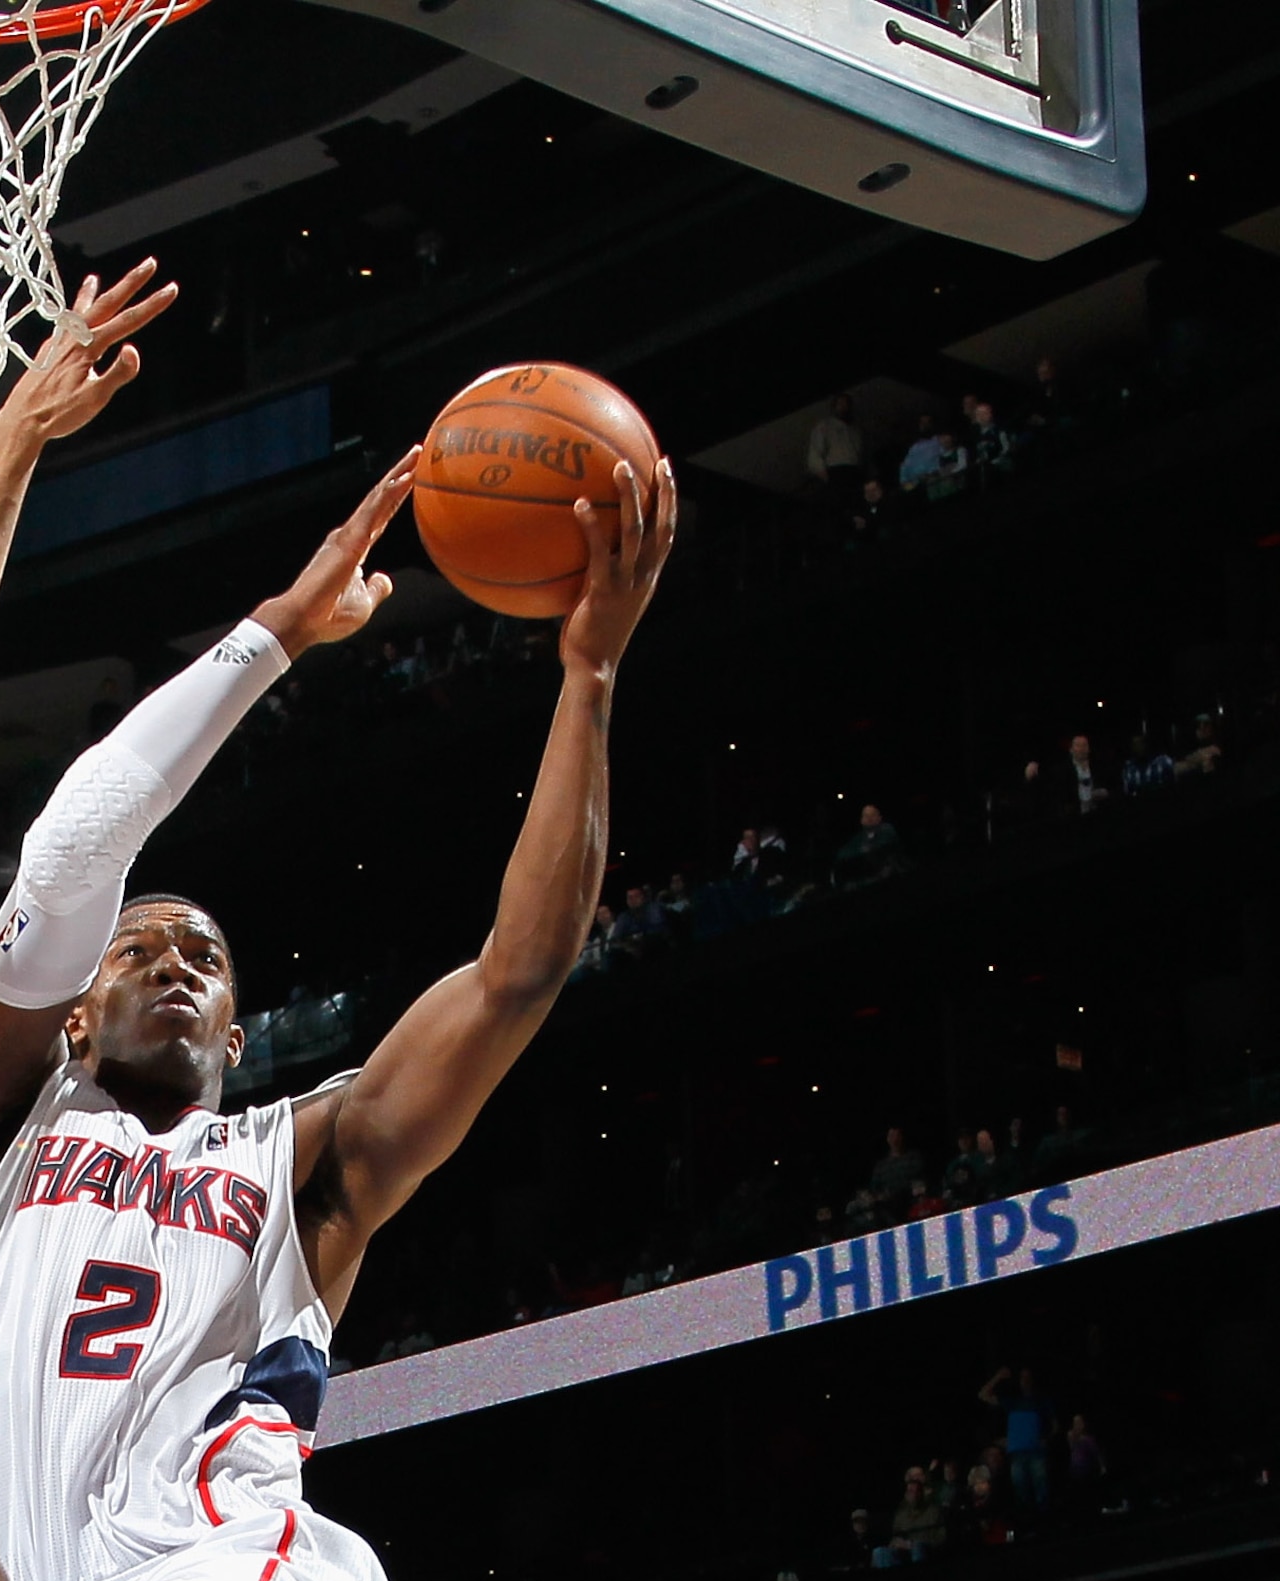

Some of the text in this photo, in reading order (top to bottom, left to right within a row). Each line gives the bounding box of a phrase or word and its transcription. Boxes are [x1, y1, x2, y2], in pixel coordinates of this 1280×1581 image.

[16, 1136, 268, 1263] HAWKS
[765, 1183, 1080, 1333] PHILIPS
[59, 1259, 162, 1380] 2
